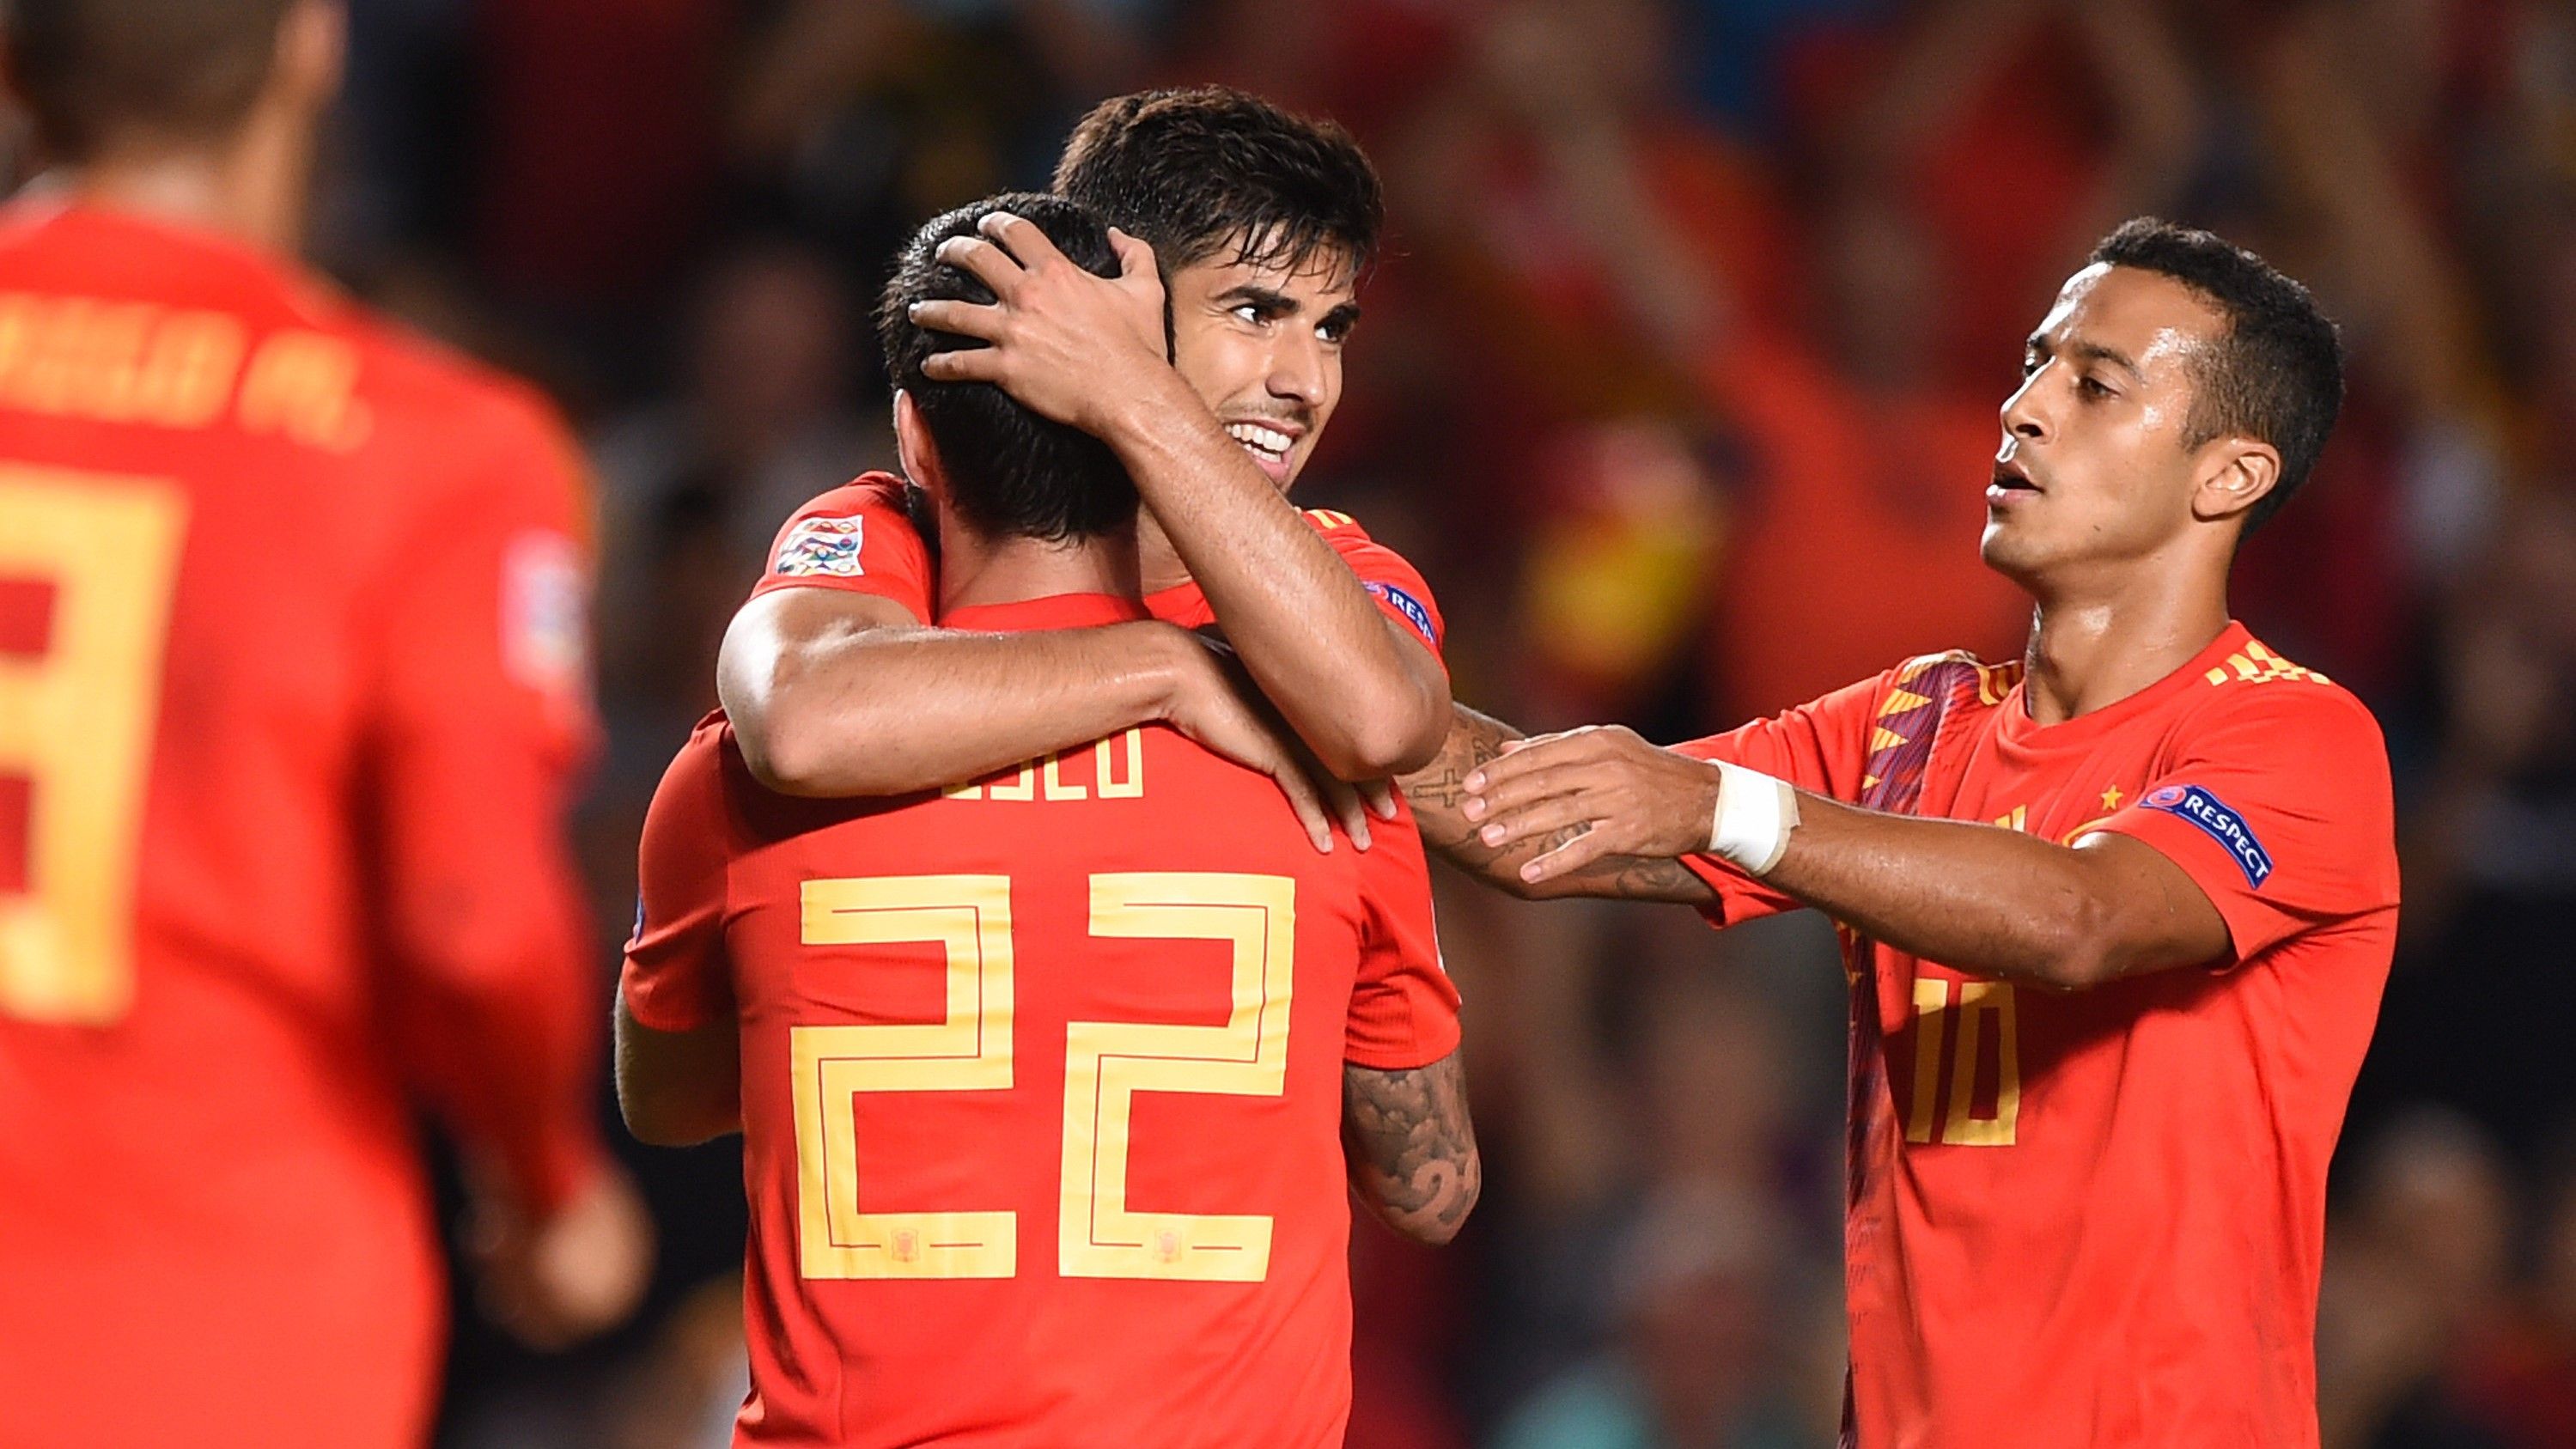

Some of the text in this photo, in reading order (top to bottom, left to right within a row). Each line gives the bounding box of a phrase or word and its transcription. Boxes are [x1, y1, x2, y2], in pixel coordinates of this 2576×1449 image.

[2184, 795, 2268, 879] RESPECT
[790, 871, 1295, 1282] 22
[1905, 977, 2020, 1146] 10
